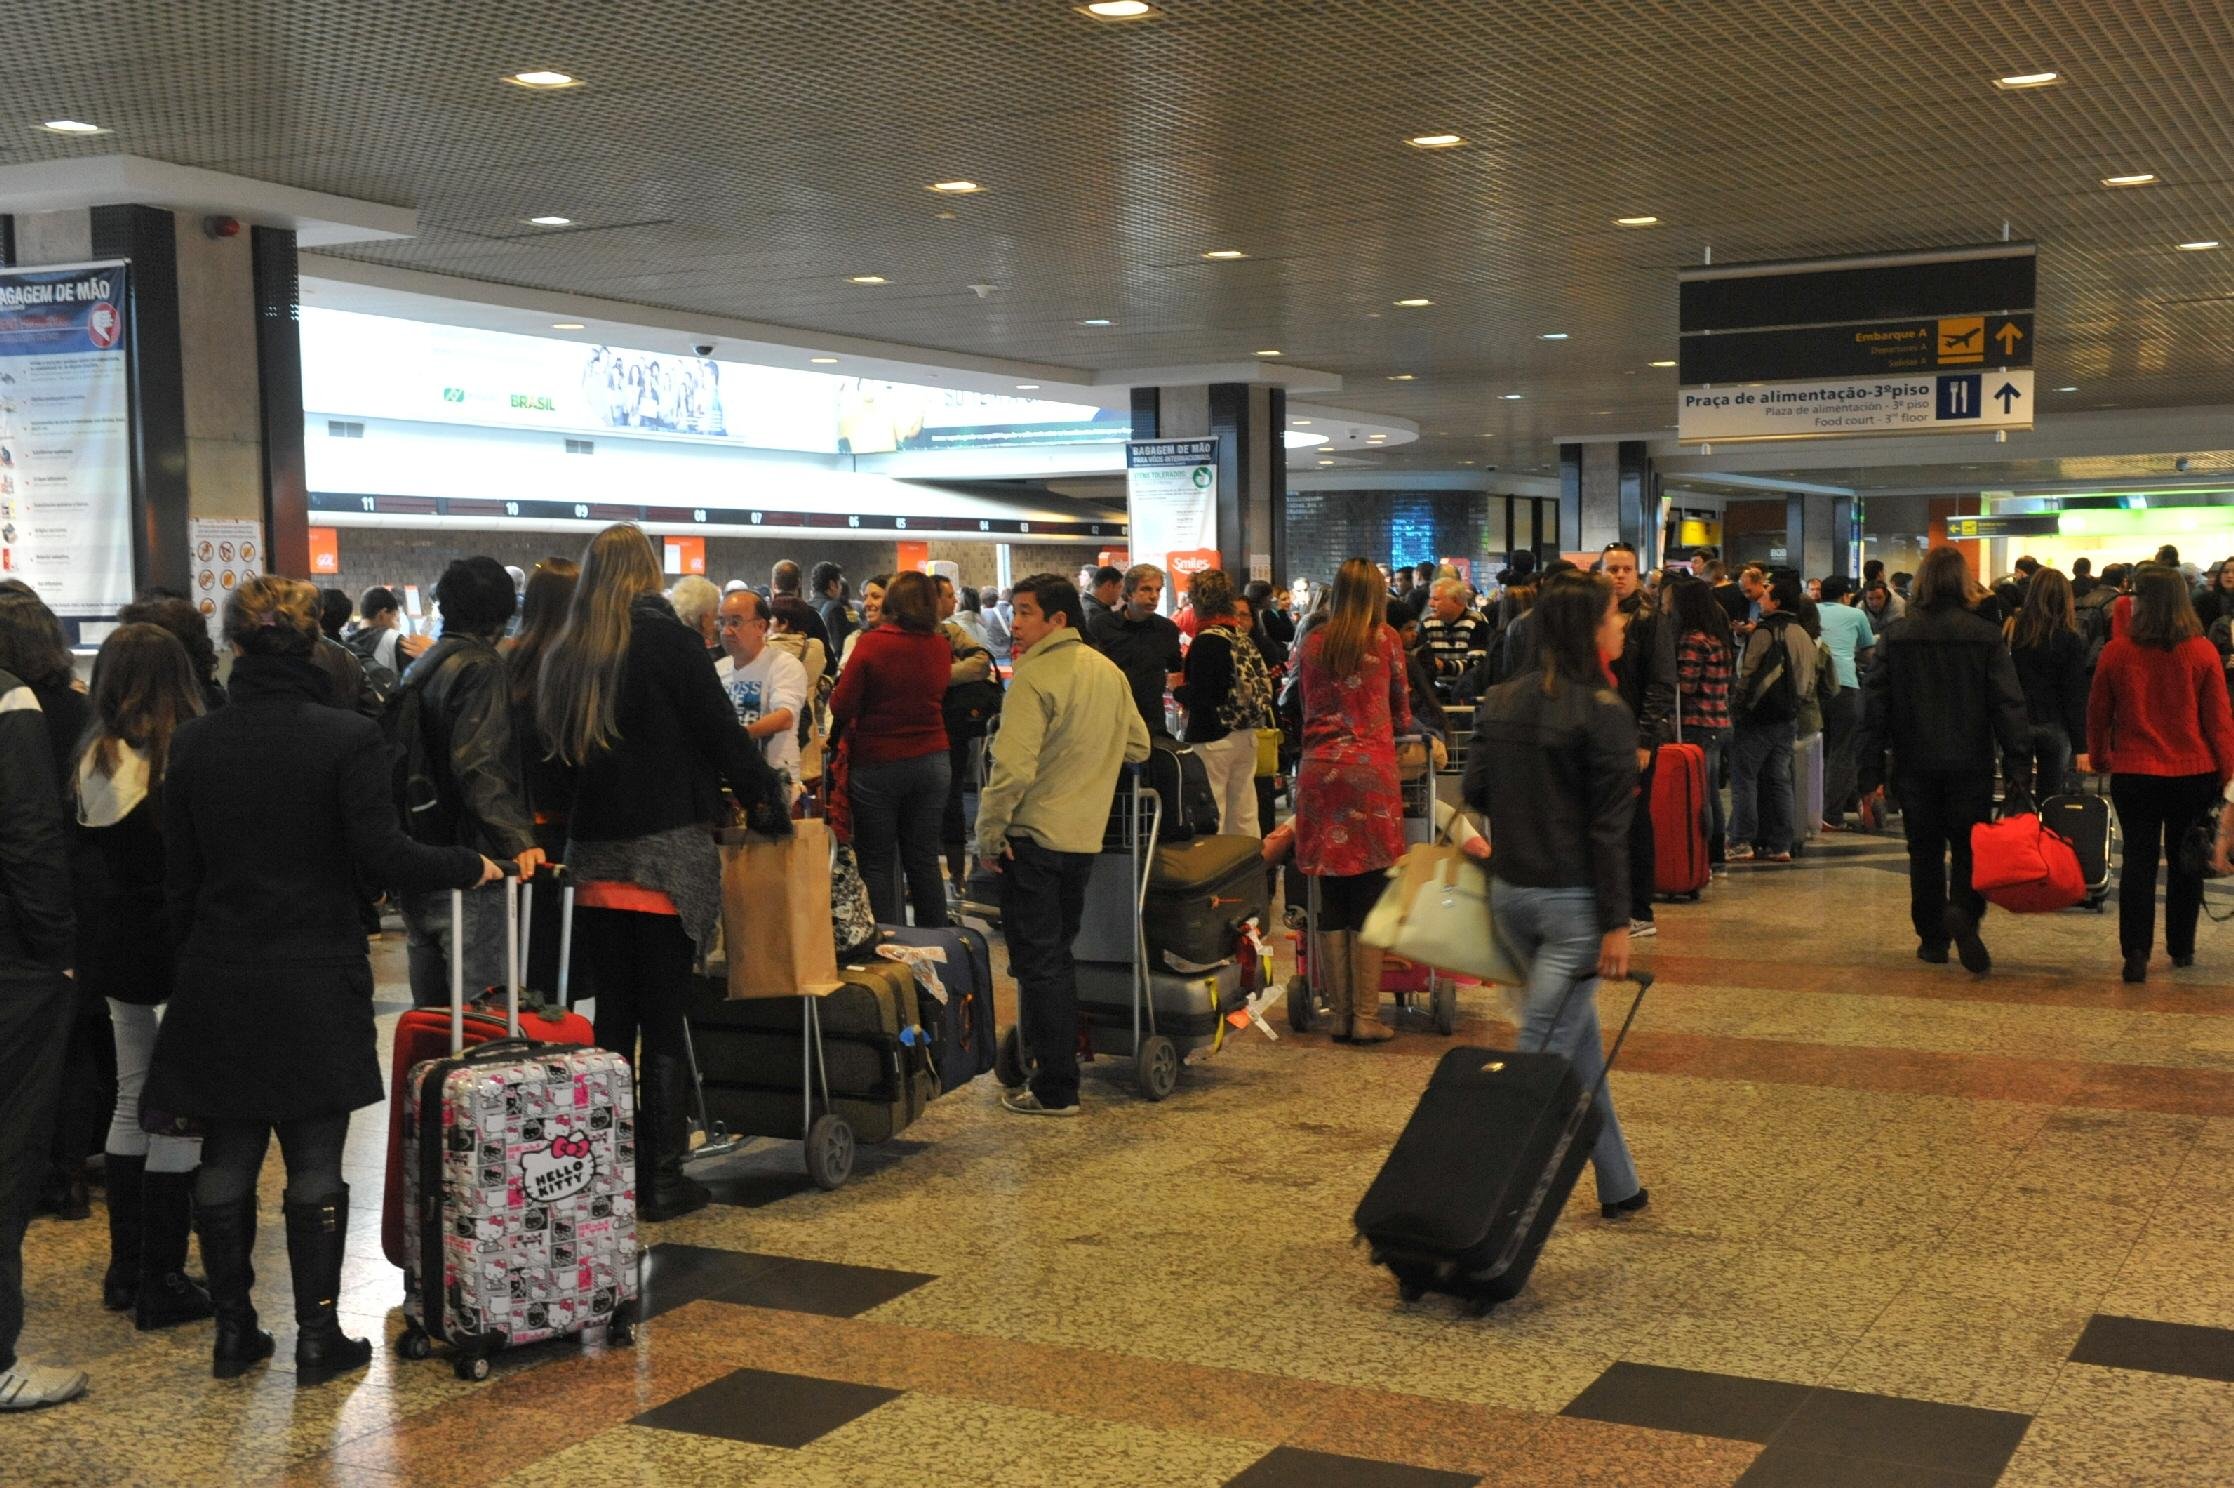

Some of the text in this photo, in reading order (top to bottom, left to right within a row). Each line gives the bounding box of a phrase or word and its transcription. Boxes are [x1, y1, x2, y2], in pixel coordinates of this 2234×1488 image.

[56, 283, 74, 302] DE
[77, 278, 110, 300] MÃO
[1855, 328, 1927, 342] Embarque A
[510, 394, 556, 411] BRASIL
[1686, 395, 1730, 409] Praça
[1735, 392, 1755, 405] de
[1766, 407, 1793, 416] Plaza
[1796, 407, 1810, 415] de
[1812, 401, 1882, 414] alimentación
[1907, 400, 1930, 410] piso
[1815, 416, 1842, 427] Food
[1845, 415, 1874, 425] court
[1901, 412, 1929, 423] floor
[1133, 442, 1211, 456] BAGAGEM DE MÃO
[361, 496, 375, 511] 11
[505, 502, 519, 516] 10
[574, 503, 589, 518] 09
[751, 512, 762, 524] 07
[1173, 556, 1210, 571] Smiles
[536, 1161, 583, 1186] HELLO
[538, 1173, 581, 1197] KITTY
